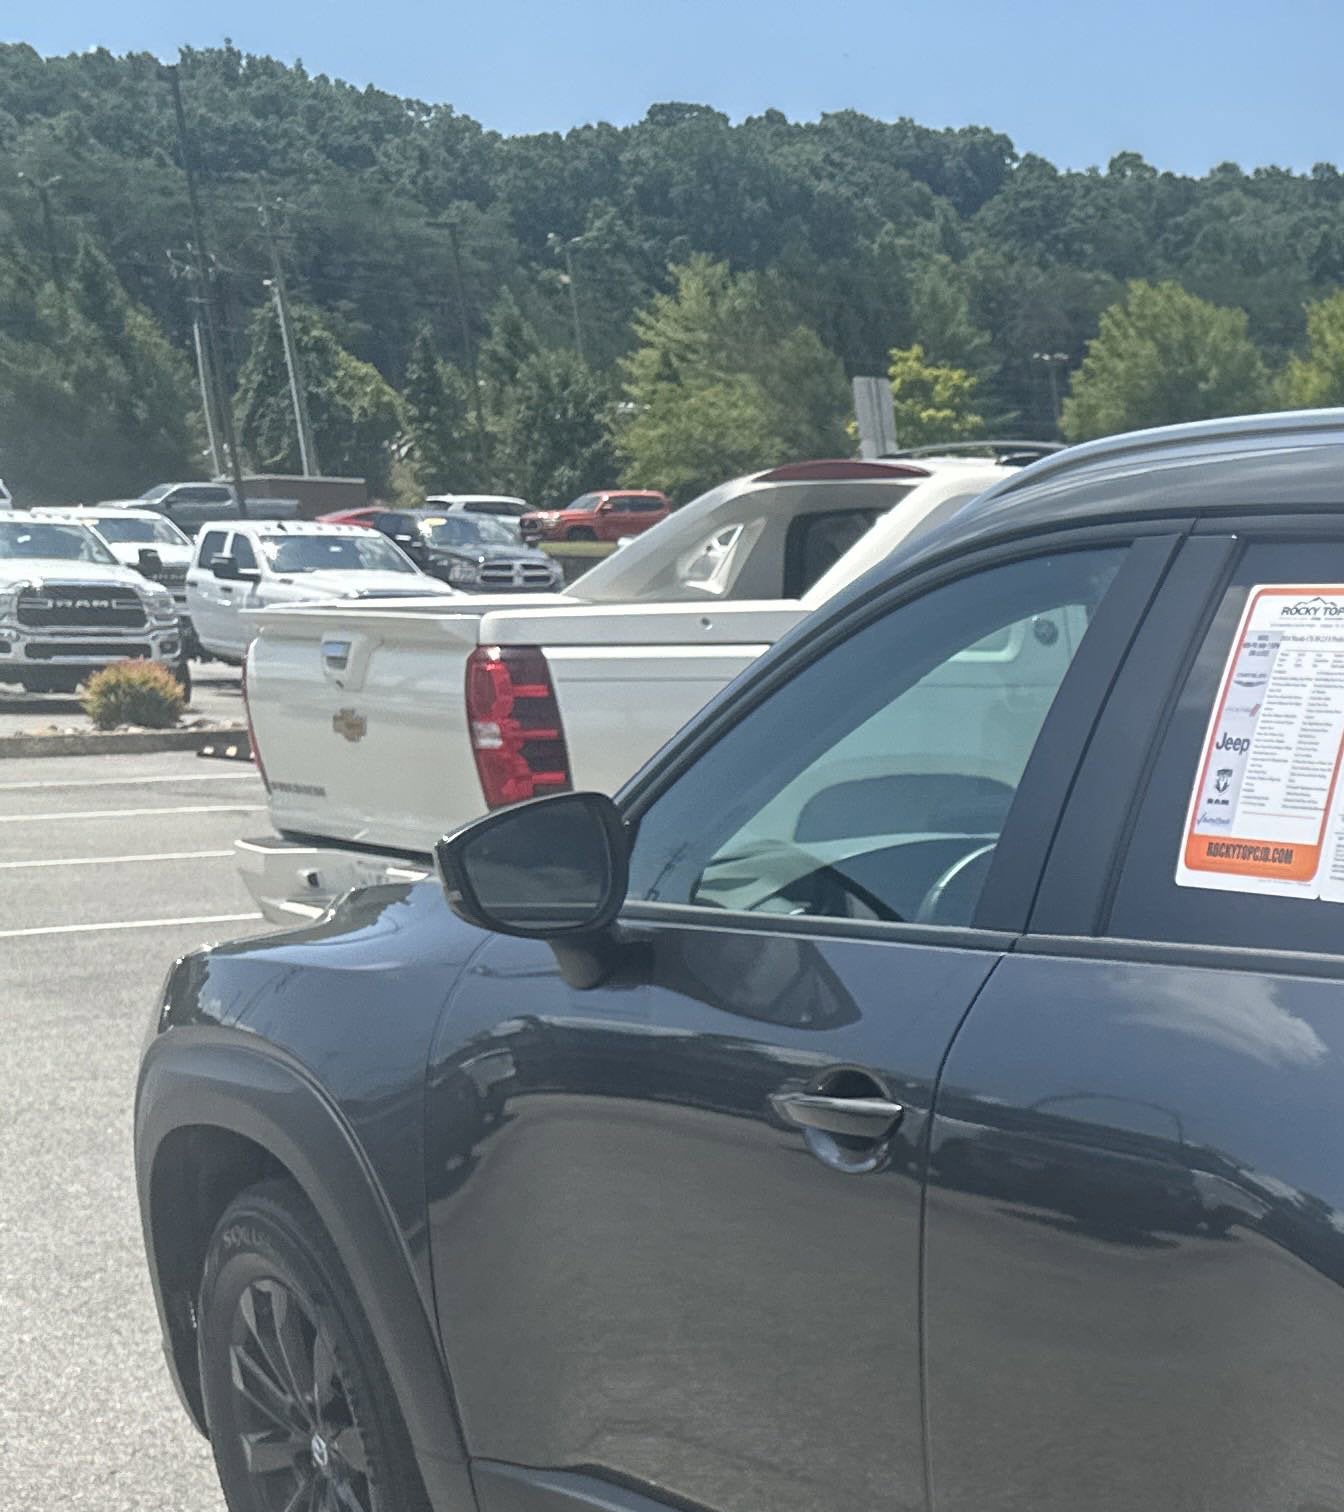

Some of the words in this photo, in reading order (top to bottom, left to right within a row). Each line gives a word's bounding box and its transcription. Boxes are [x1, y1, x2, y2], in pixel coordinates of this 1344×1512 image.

[55, 599, 109, 609] RAM
[1281, 606, 1318, 616] ROCKY
[1216, 732, 1250, 755] Jeep
